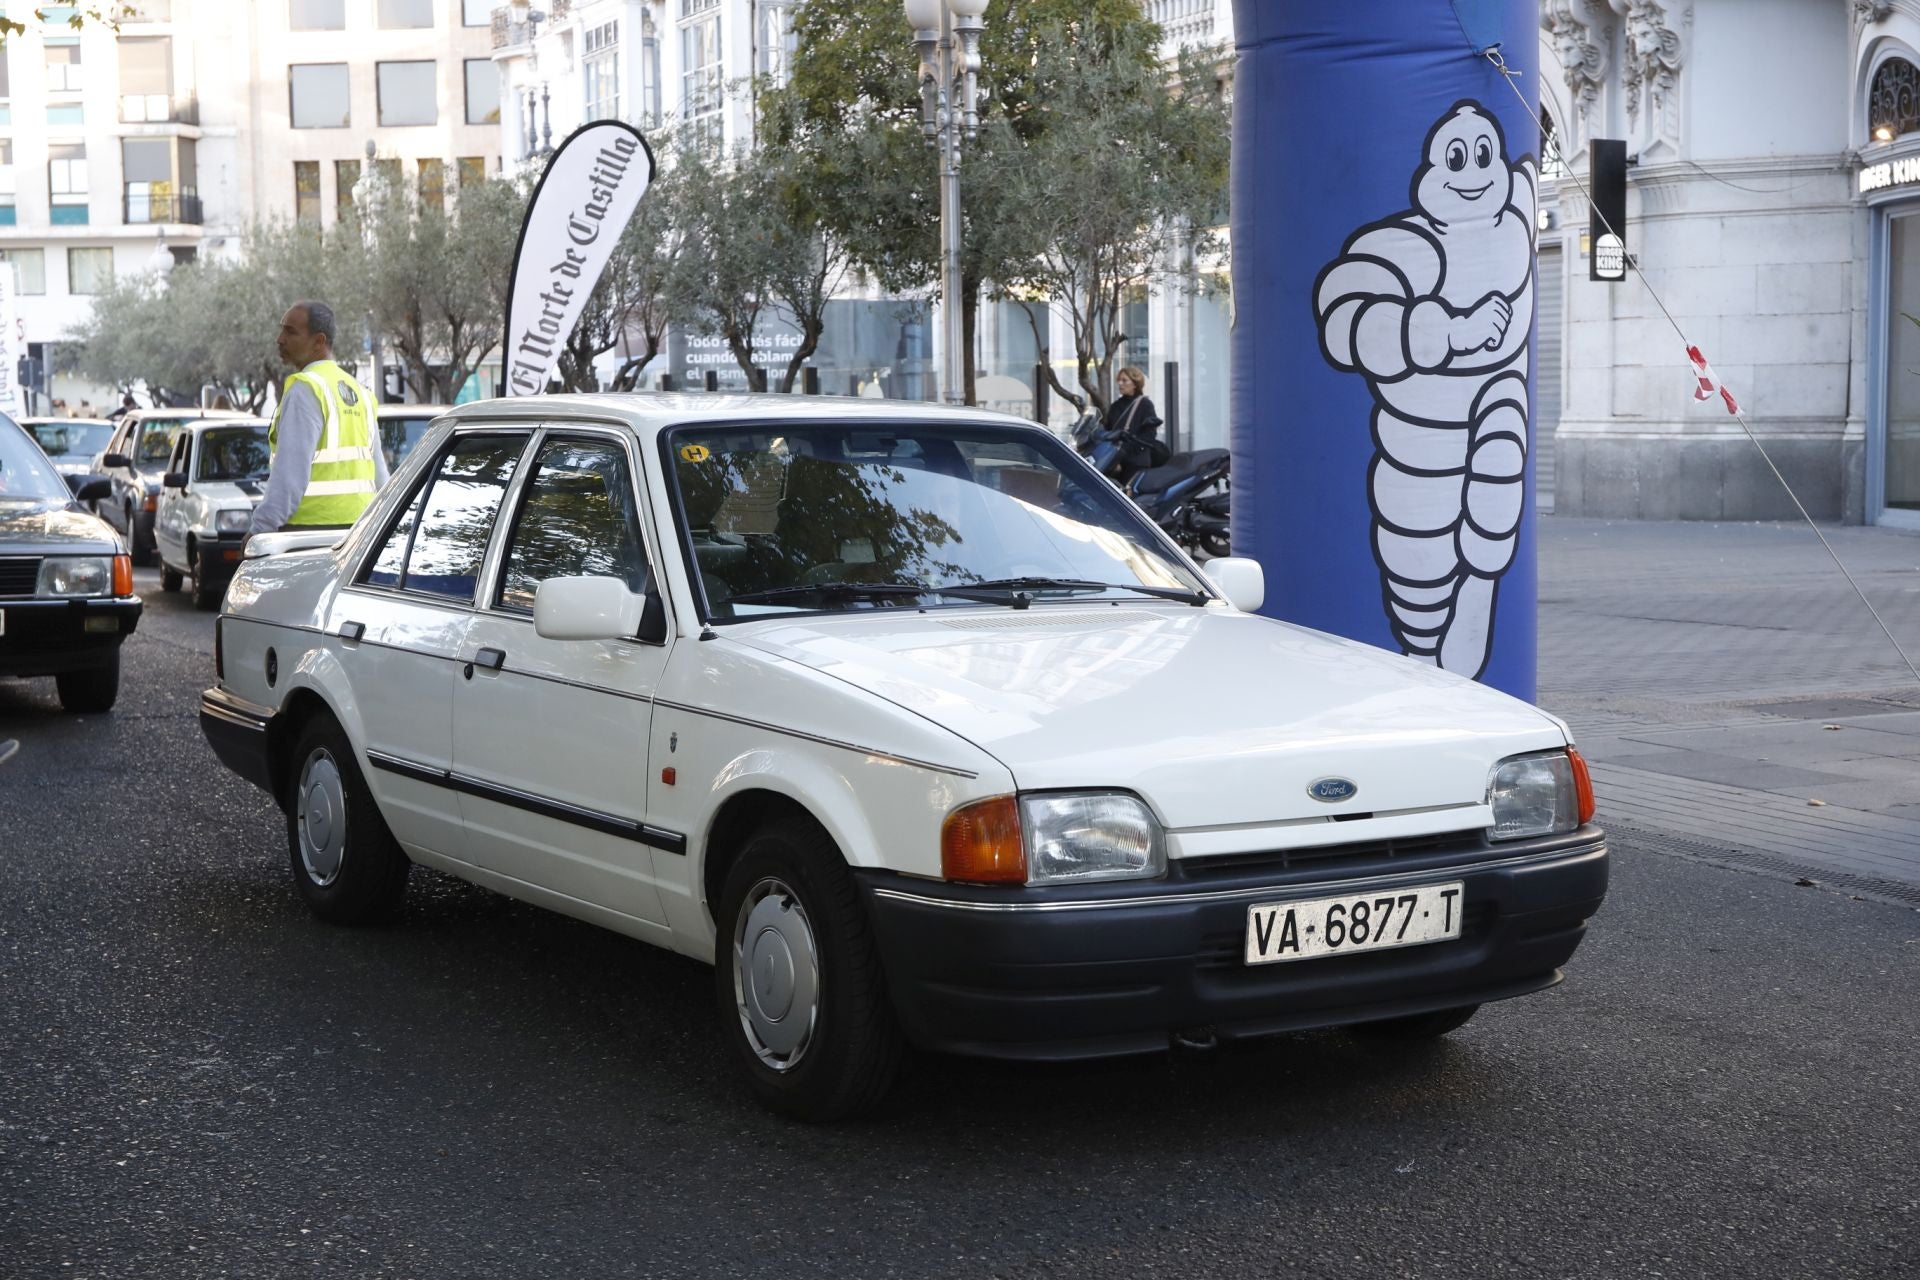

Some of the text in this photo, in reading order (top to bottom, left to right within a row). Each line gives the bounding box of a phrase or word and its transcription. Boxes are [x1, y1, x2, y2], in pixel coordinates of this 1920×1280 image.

[567, 136, 639, 246] Castilla
[1596, 247, 1624, 257] BURGER
[550, 247, 587, 279] de
[1596, 256, 1624, 270] KING
[518, 280, 574, 359] Norte
[685, 334, 720, 348] Todo
[685, 350, 738, 364] cuando
[686, 366, 701, 380] el
[685, 446, 704, 461] H
[1319, 781, 1347, 796] Ford
